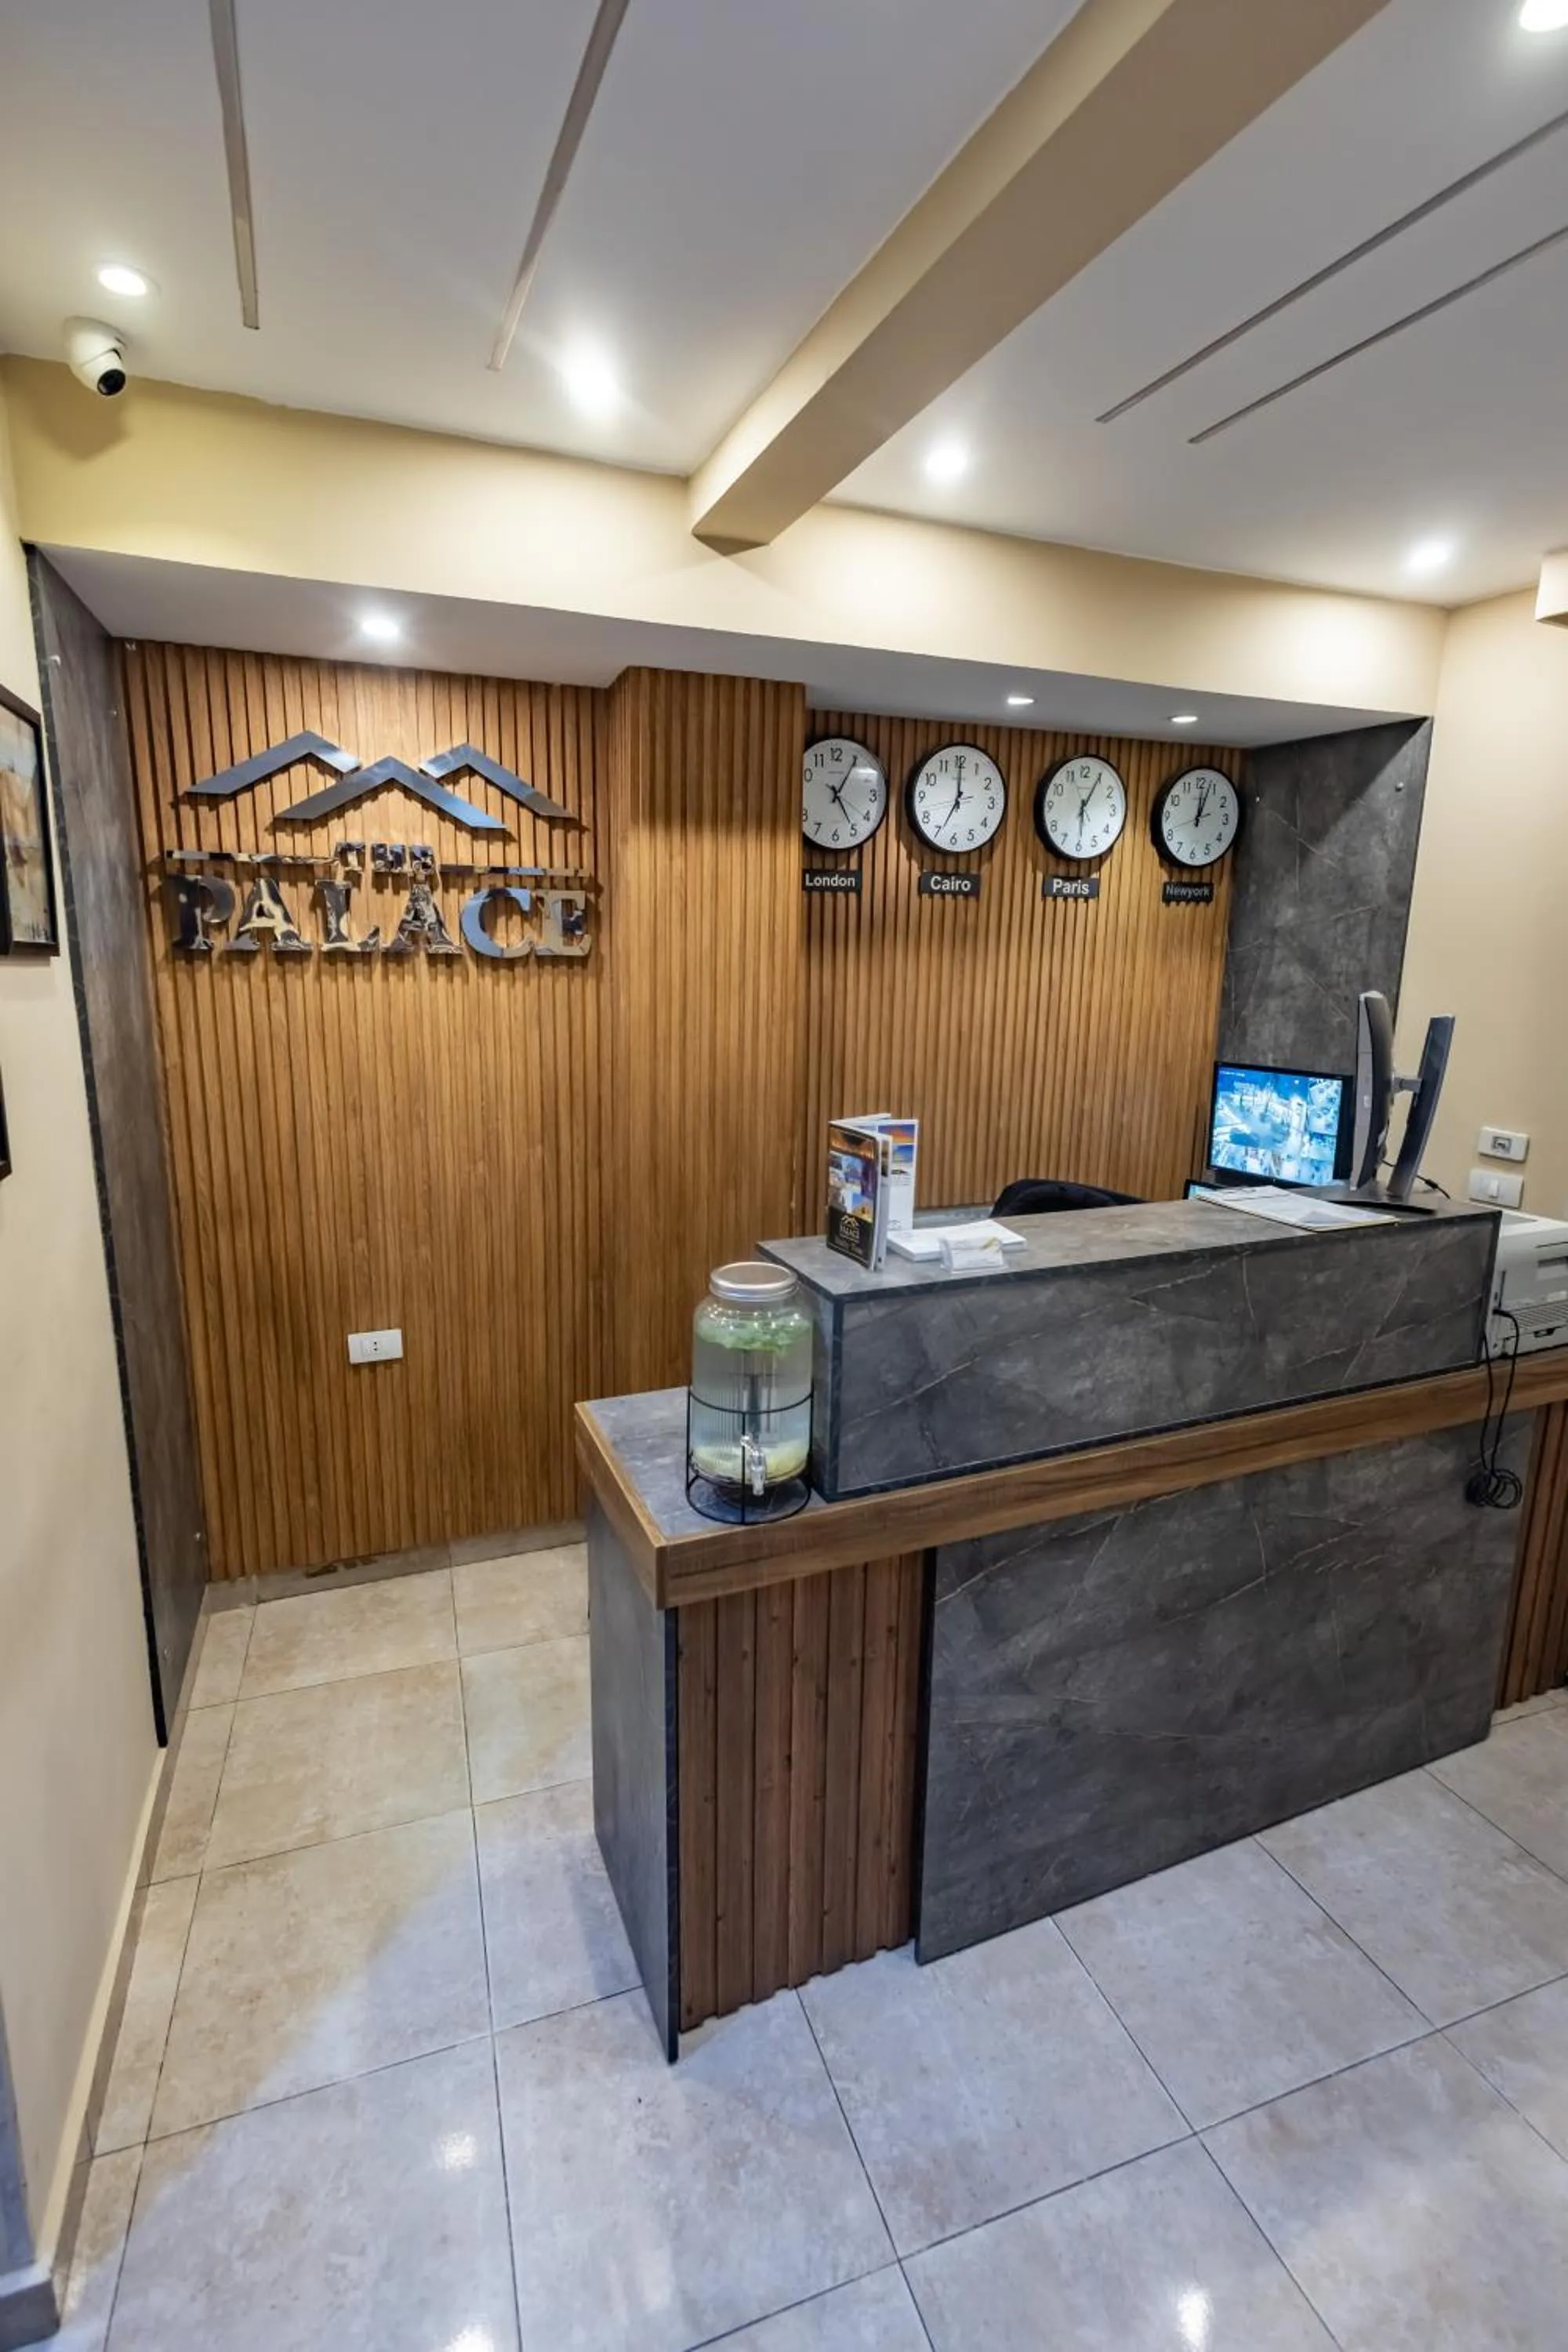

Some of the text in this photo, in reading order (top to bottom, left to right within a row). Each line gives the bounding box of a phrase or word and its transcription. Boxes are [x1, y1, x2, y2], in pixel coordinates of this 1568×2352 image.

[815, 754, 824, 768] 11
[830, 748, 843, 762] 12
[939, 760, 949, 772] 11
[975, 763, 979, 775] 1
[1080, 765, 1091, 778] 12
[804, 768, 813, 782] 0
[926, 773, 936, 786] 10
[1066, 770, 1075, 782] 11
[984, 778, 992, 790] 2
[1183, 782, 1190, 793] 11
[1196, 778, 1205, 789] 12
[1213, 784, 1216, 795] 1
[869, 790, 877, 803] 3
[1054, 784, 1064, 797] 10
[1107, 786, 1113, 798] 2
[919, 791, 925, 803] 9
[988, 797, 995, 809] 3
[1171, 795, 1179, 806] 10
[1220, 797, 1226, 808] 2
[1047, 800, 1054, 813] 9
[1110, 804, 1116, 817] 3
[863, 810, 870, 822] 4
[922, 811, 930, 823] 8
[1165, 811, 1170, 821] 9
[1222, 814, 1228, 825] 3
[814, 823, 822, 835] 7
[980, 818, 987, 828] 4
[1051, 820, 1057, 833] 8
[1104, 823, 1109, 833] 4
[832, 829, 840, 842] 6
[850, 824, 857, 837] 5
[935, 826, 941, 837] 7
[967, 829, 975, 841] 5
[1167, 829, 1173, 840] 8
[950, 833, 957, 845] 6
[1061, 833, 1068, 845] 7
[1091, 836, 1098, 848] 5
[1216, 833, 1221, 842] 4
[1076, 840, 1082, 852] 6
[1175, 842, 1182, 854] 7
[1204, 844, 1210, 855] 5
[336, 842, 433, 872] THE
[1190, 848, 1196, 860] 6
[805, 873, 855, 887] London
[931, 876, 971, 891] Cairo
[1053, 879, 1089, 895] Paris
[172, 875, 592, 958] PALACE
